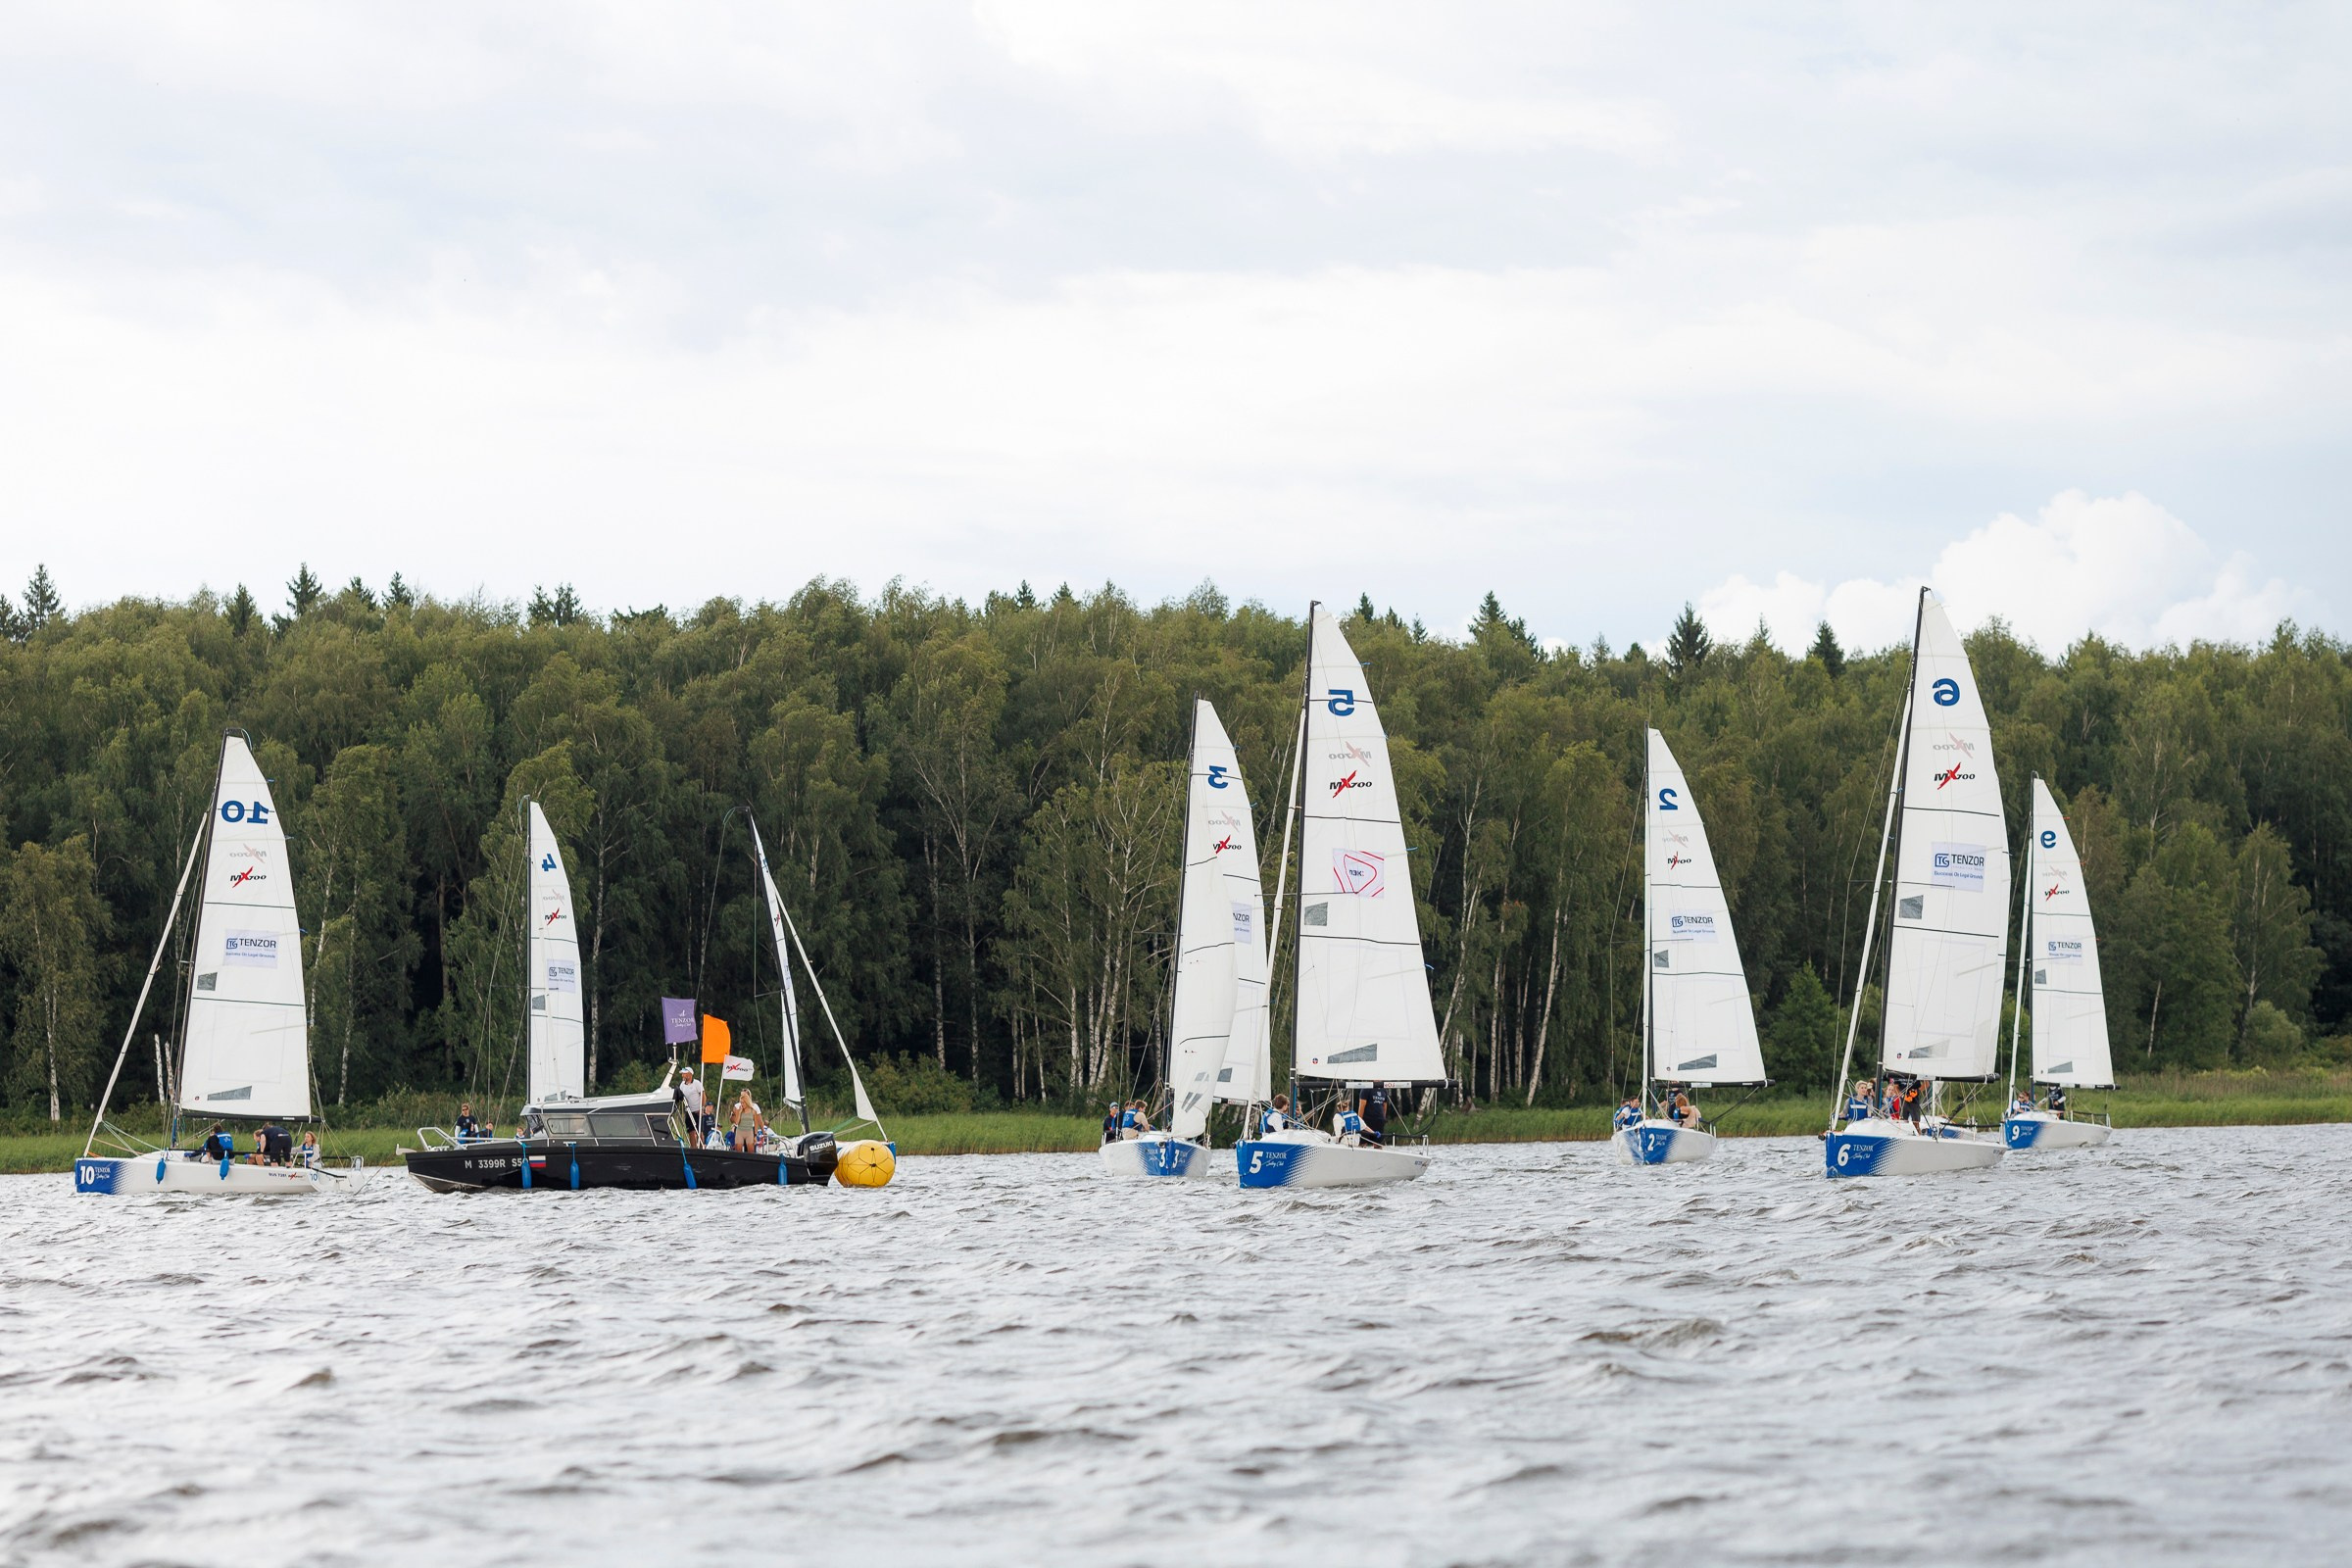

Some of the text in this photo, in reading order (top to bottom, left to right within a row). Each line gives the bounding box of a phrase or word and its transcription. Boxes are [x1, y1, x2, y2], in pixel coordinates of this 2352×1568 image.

[1329, 770, 1372, 799] MX700
[1934, 761, 1976, 790] MX700
[1951, 854, 1984, 866] TENZOR
[230, 865, 268, 888] MX700
[1684, 915, 1714, 924] TENZOR
[239, 938, 277, 949] TENZOR
[2012, 1125, 2020, 1141] 9
[808, 1140, 834, 1152] SUZUKI
[1647, 1134, 1655, 1151] 2
[478, 1158, 506, 1168] 3399R
[1158, 1148, 1166, 1167] 3
[1250, 1151, 1263, 1174] 5
[1838, 1144, 1851, 1166] 6
[80, 1165, 95, 1185] 10
